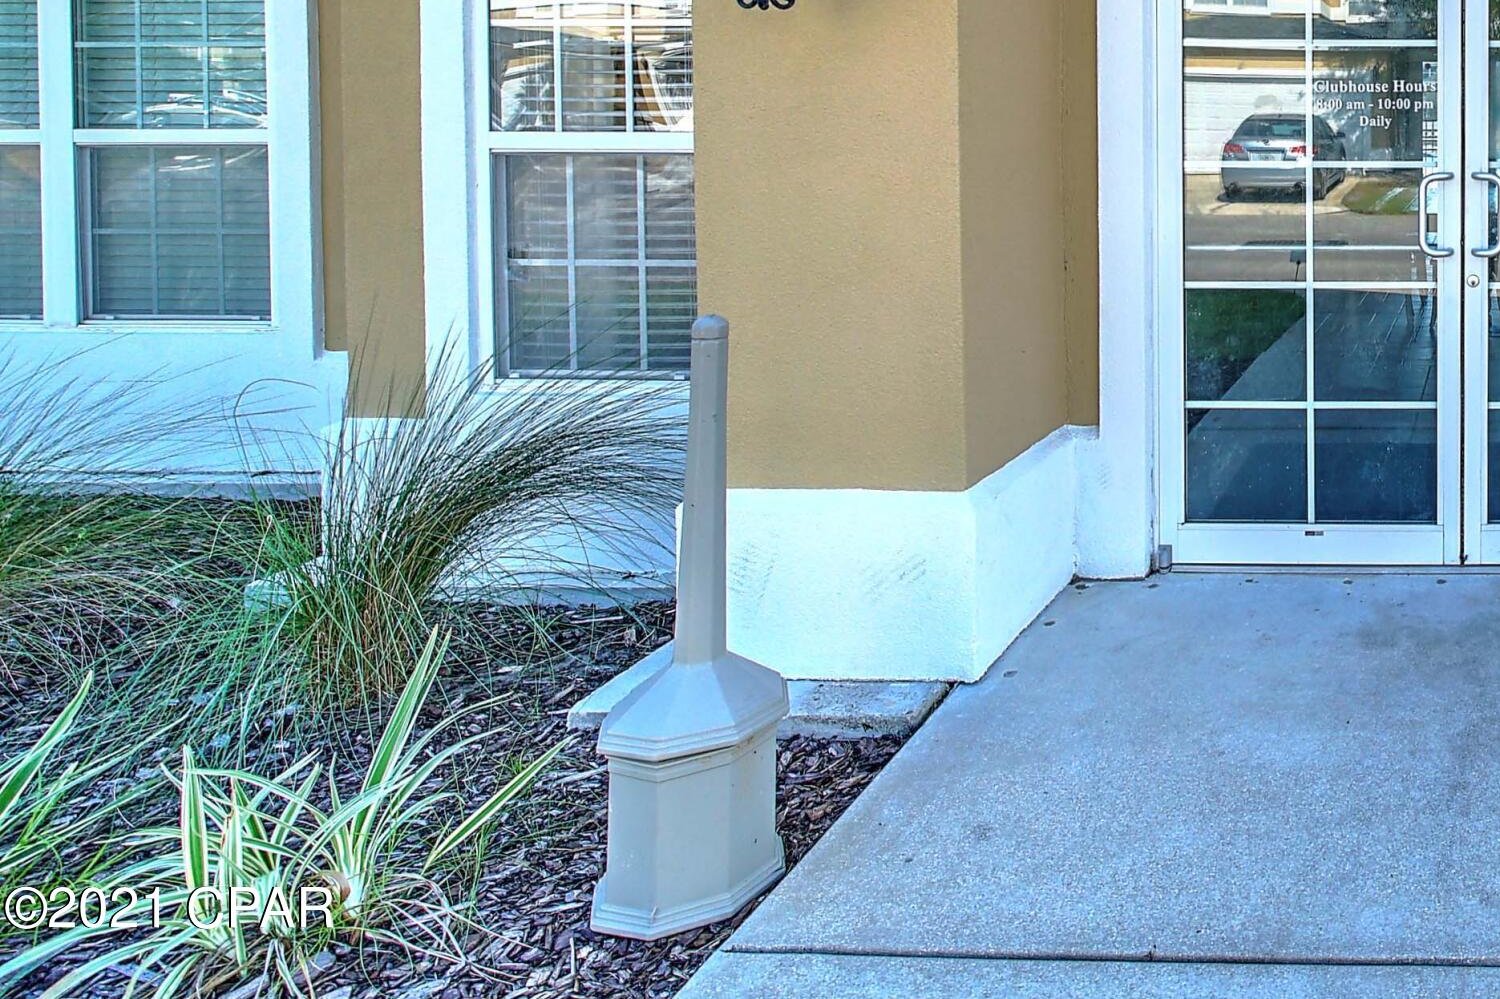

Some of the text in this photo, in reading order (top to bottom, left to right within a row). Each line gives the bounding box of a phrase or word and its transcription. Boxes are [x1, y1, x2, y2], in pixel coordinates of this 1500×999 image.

[1313, 80, 1437, 93] Clubhouse Hours
[1316, 98, 1343, 110] 8:00
[1346, 101, 1365, 110] am
[1378, 98, 1411, 110] 10:00
[1414, 101, 1434, 112] pm
[1359, 115, 1392, 129] Daily
